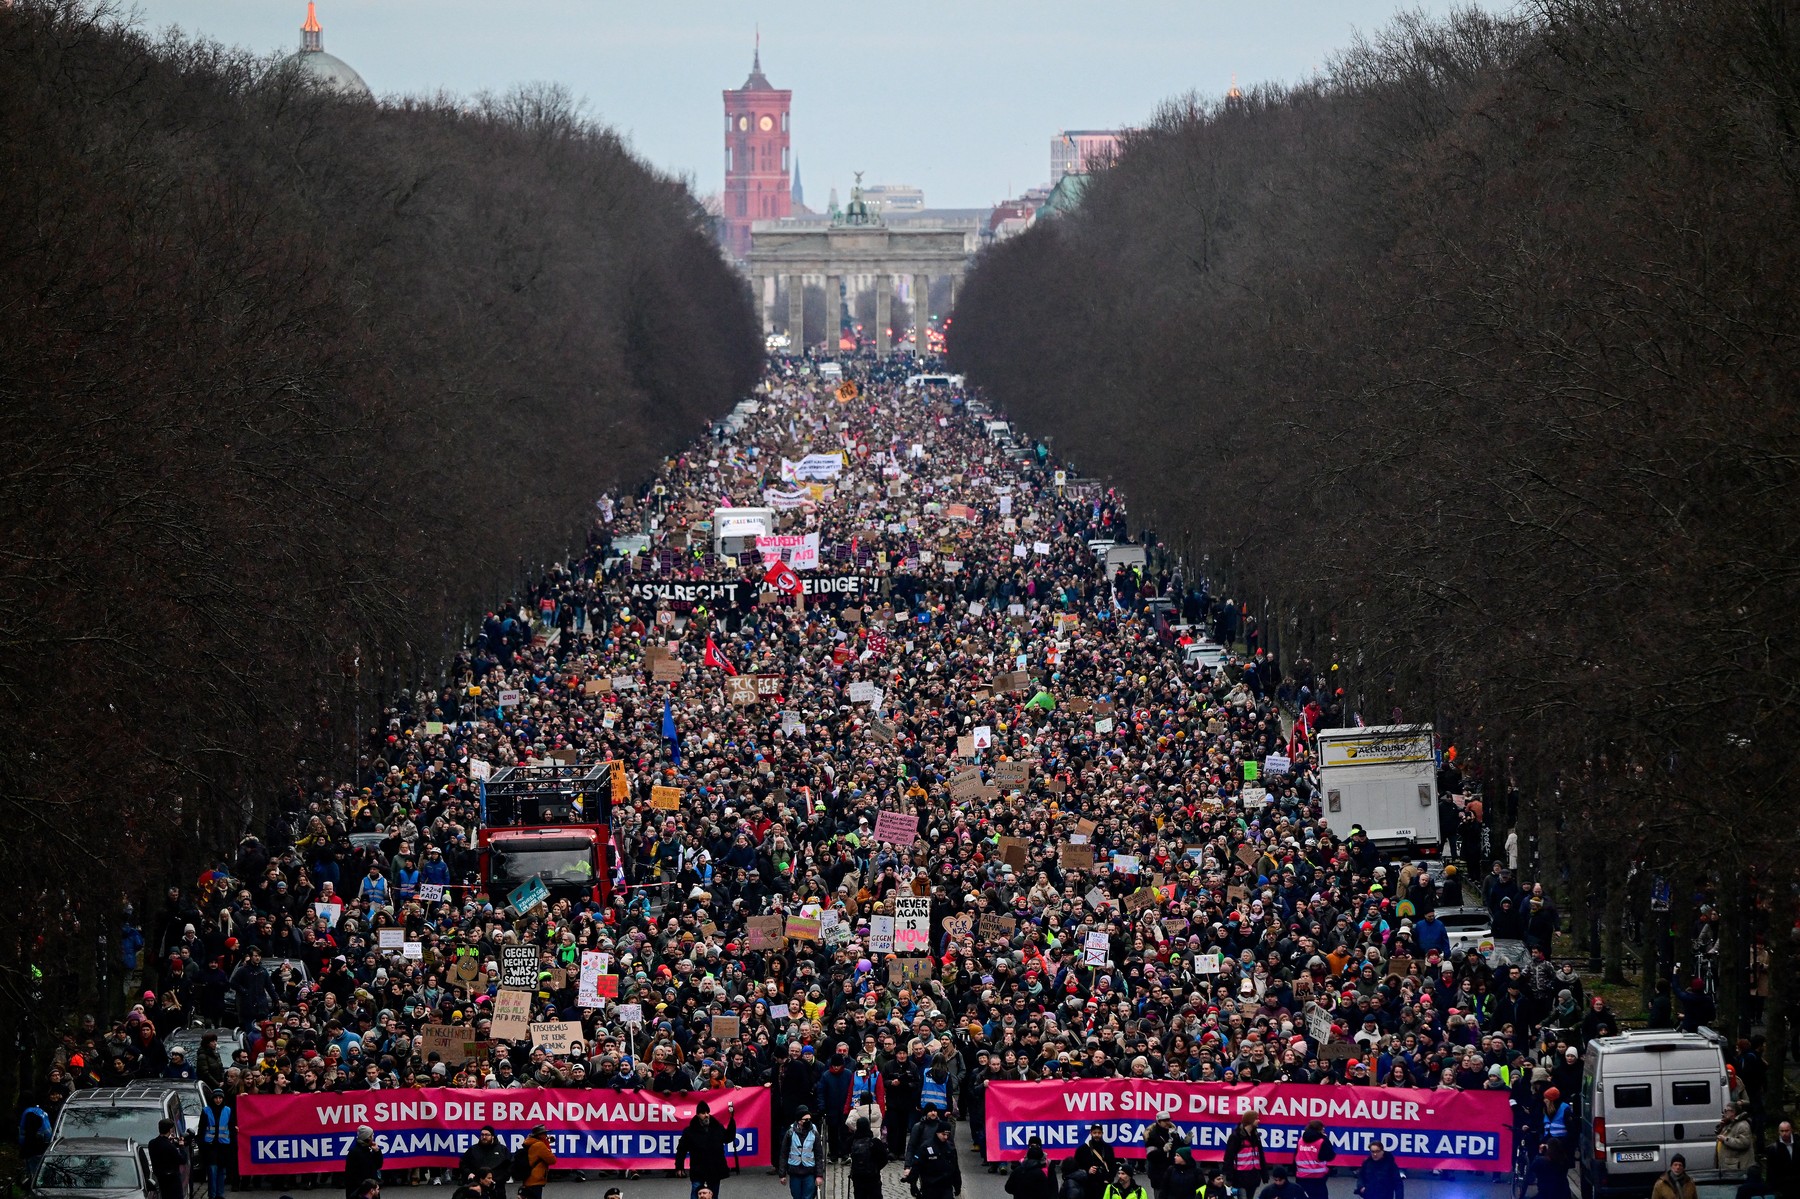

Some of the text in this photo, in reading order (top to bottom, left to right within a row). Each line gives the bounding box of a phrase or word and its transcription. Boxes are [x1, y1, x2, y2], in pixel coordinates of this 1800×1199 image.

[755, 536, 805, 547] ASYLRECHT
[1358, 744, 1407, 753] ALLROUND
[421, 885, 441, 894] 2+2=4
[896, 899, 928, 909] NEVER
[897, 908, 928, 918] AGAIN
[906, 919, 917, 929] IS
[949, 920, 967, 928] FCK
[896, 929, 929, 942] NOW
[505, 948, 535, 958] GEGEN
[503, 958, 538, 971] RECHTS!
[533, 1023, 568, 1032] FASCHISMUS
[1063, 1092, 1115, 1112] WIR
[1120, 1091, 1182, 1113] SIND
[1189, 1094, 1229, 1115] DIE
[1236, 1096, 1420, 1121] BRANDMAUER
[316, 1103, 370, 1125] WIR
[374, 1101, 438, 1122] SIND
[444, 1102, 486, 1121] DIE
[492, 1101, 678, 1123] BRANDMAUER
[1005, 1125, 1079, 1147] KEINE
[1329, 1131, 1376, 1151] MIT
[1380, 1132, 1430, 1154] DER
[1434, 1134, 1495, 1156] AFD!
[258, 1137, 333, 1159] KEINE
[586, 1134, 633, 1154] MIT
